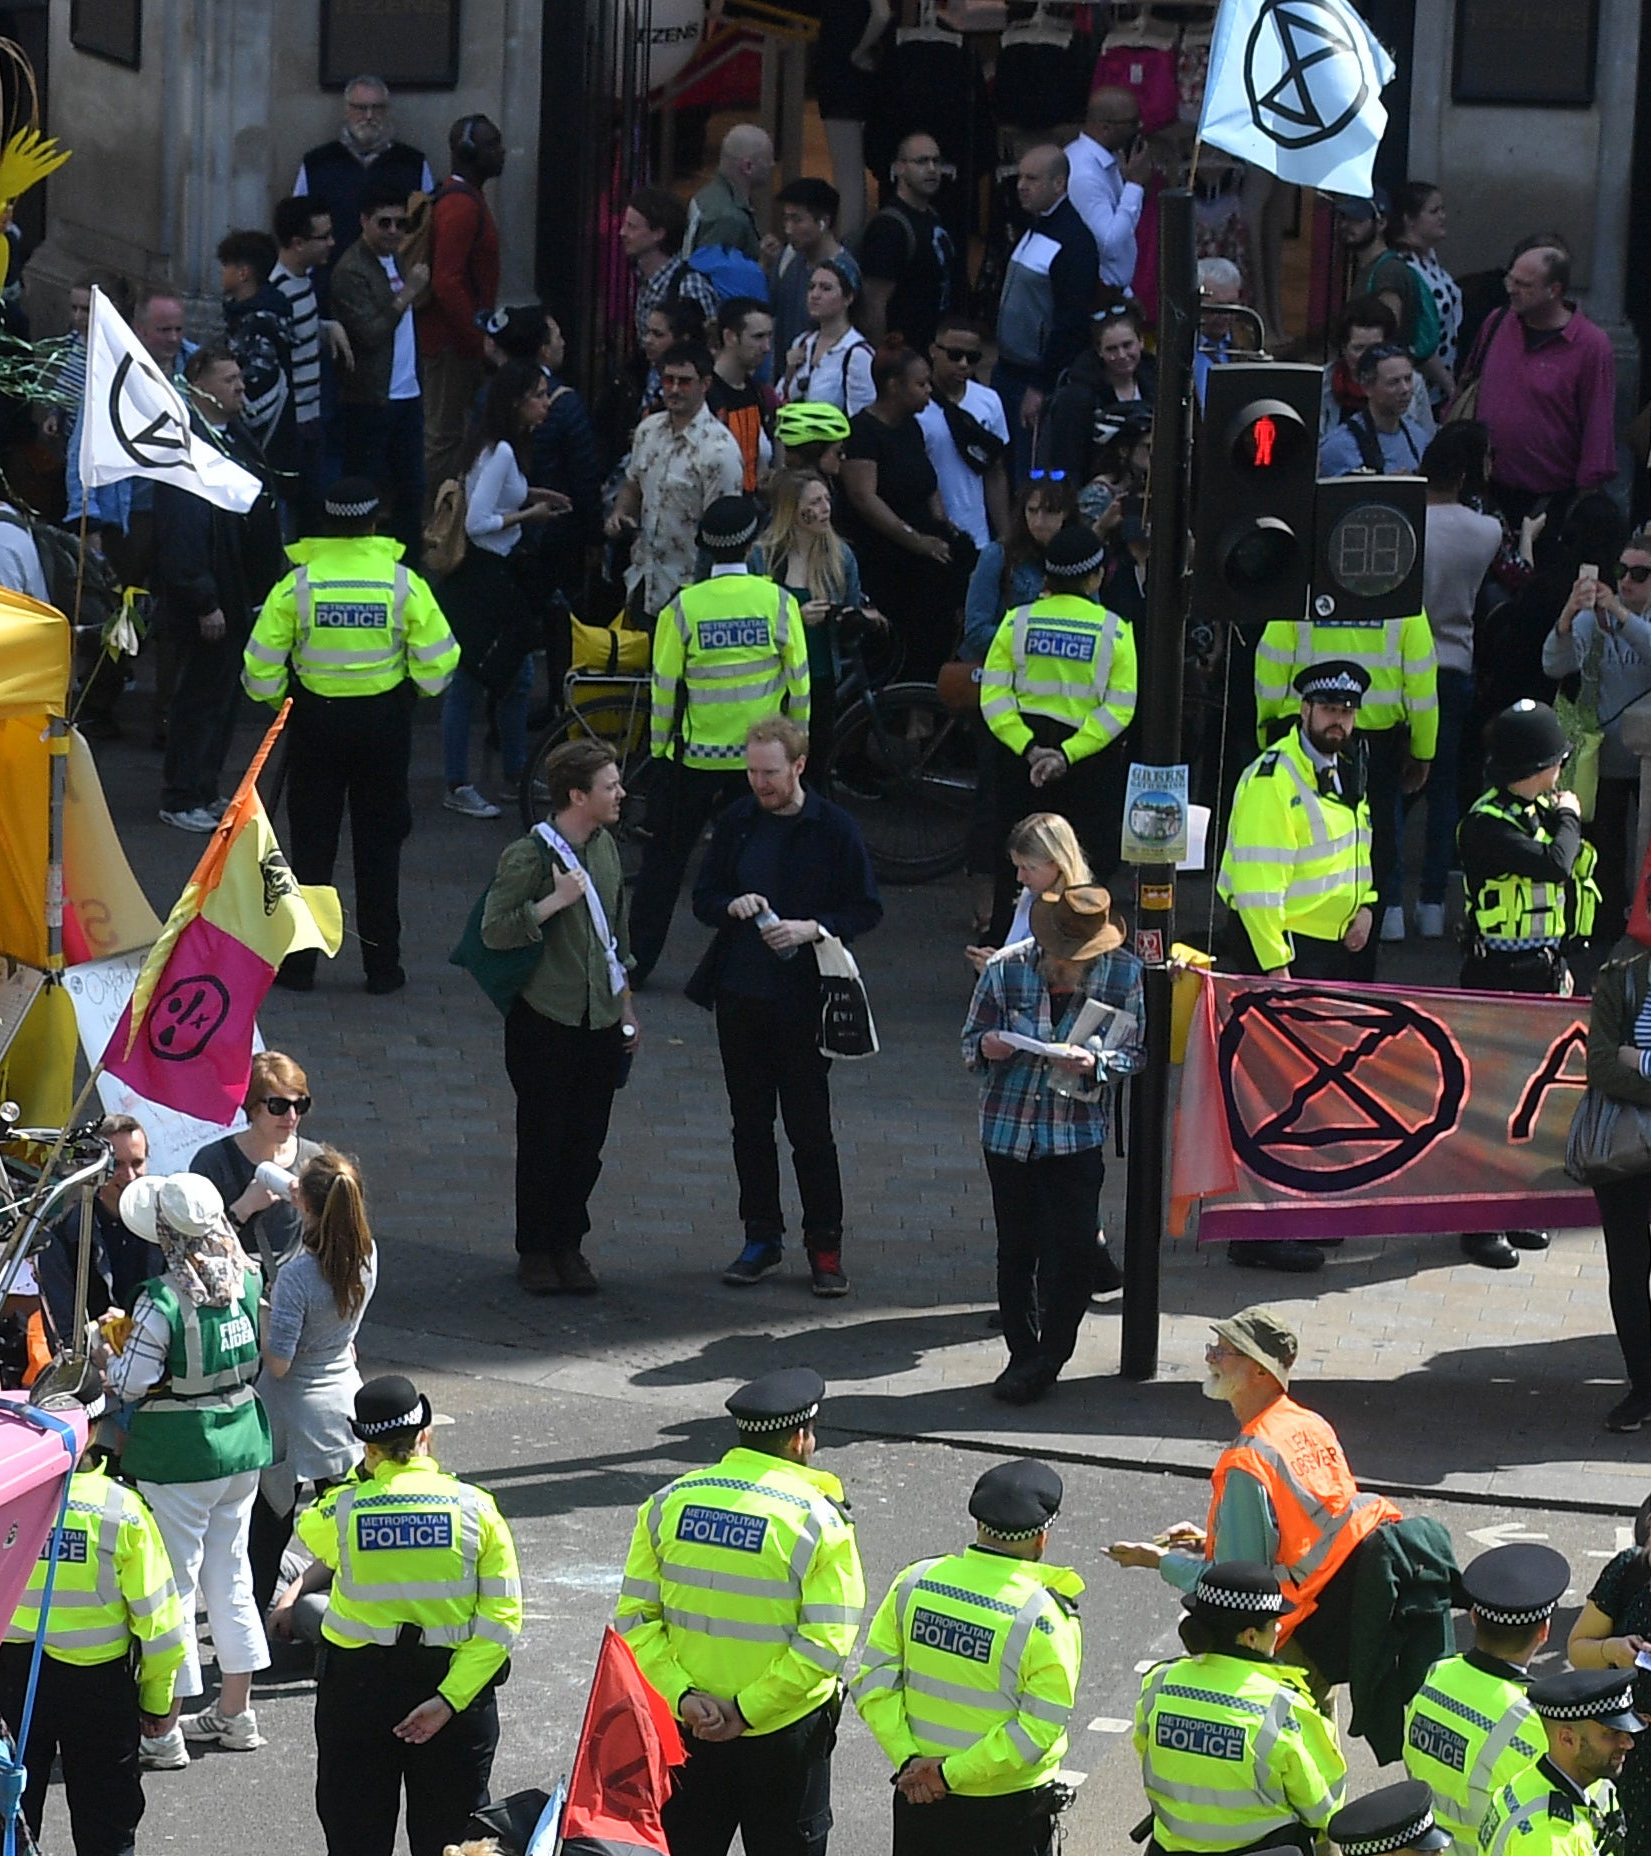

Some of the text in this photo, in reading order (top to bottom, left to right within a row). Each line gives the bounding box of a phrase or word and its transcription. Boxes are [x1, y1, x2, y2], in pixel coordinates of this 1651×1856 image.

[315, 603, 387, 613] METROPOLITAN
[316, 611, 387, 628] POLICE
[699, 630, 769, 650] POLICE
[1025, 638, 1094, 661] POLICE
[1131, 767, 1186, 785] GREEN
[360, 1514, 447, 1527] METROPOLITAN
[683, 1507, 765, 1529] METROPOLITAN
[361, 1525, 450, 1549] POLICE
[679, 1518, 760, 1550] POLICE
[42, 1541, 86, 1561] ICE
[915, 1609, 993, 1642] METROPOLITAN
[912, 1621, 990, 1661] POLICE
[1158, 1714, 1245, 1740] METROPOLITAN
[1156, 1724, 1244, 1759] POLICE
[1410, 1722, 1465, 1772] POLICE
